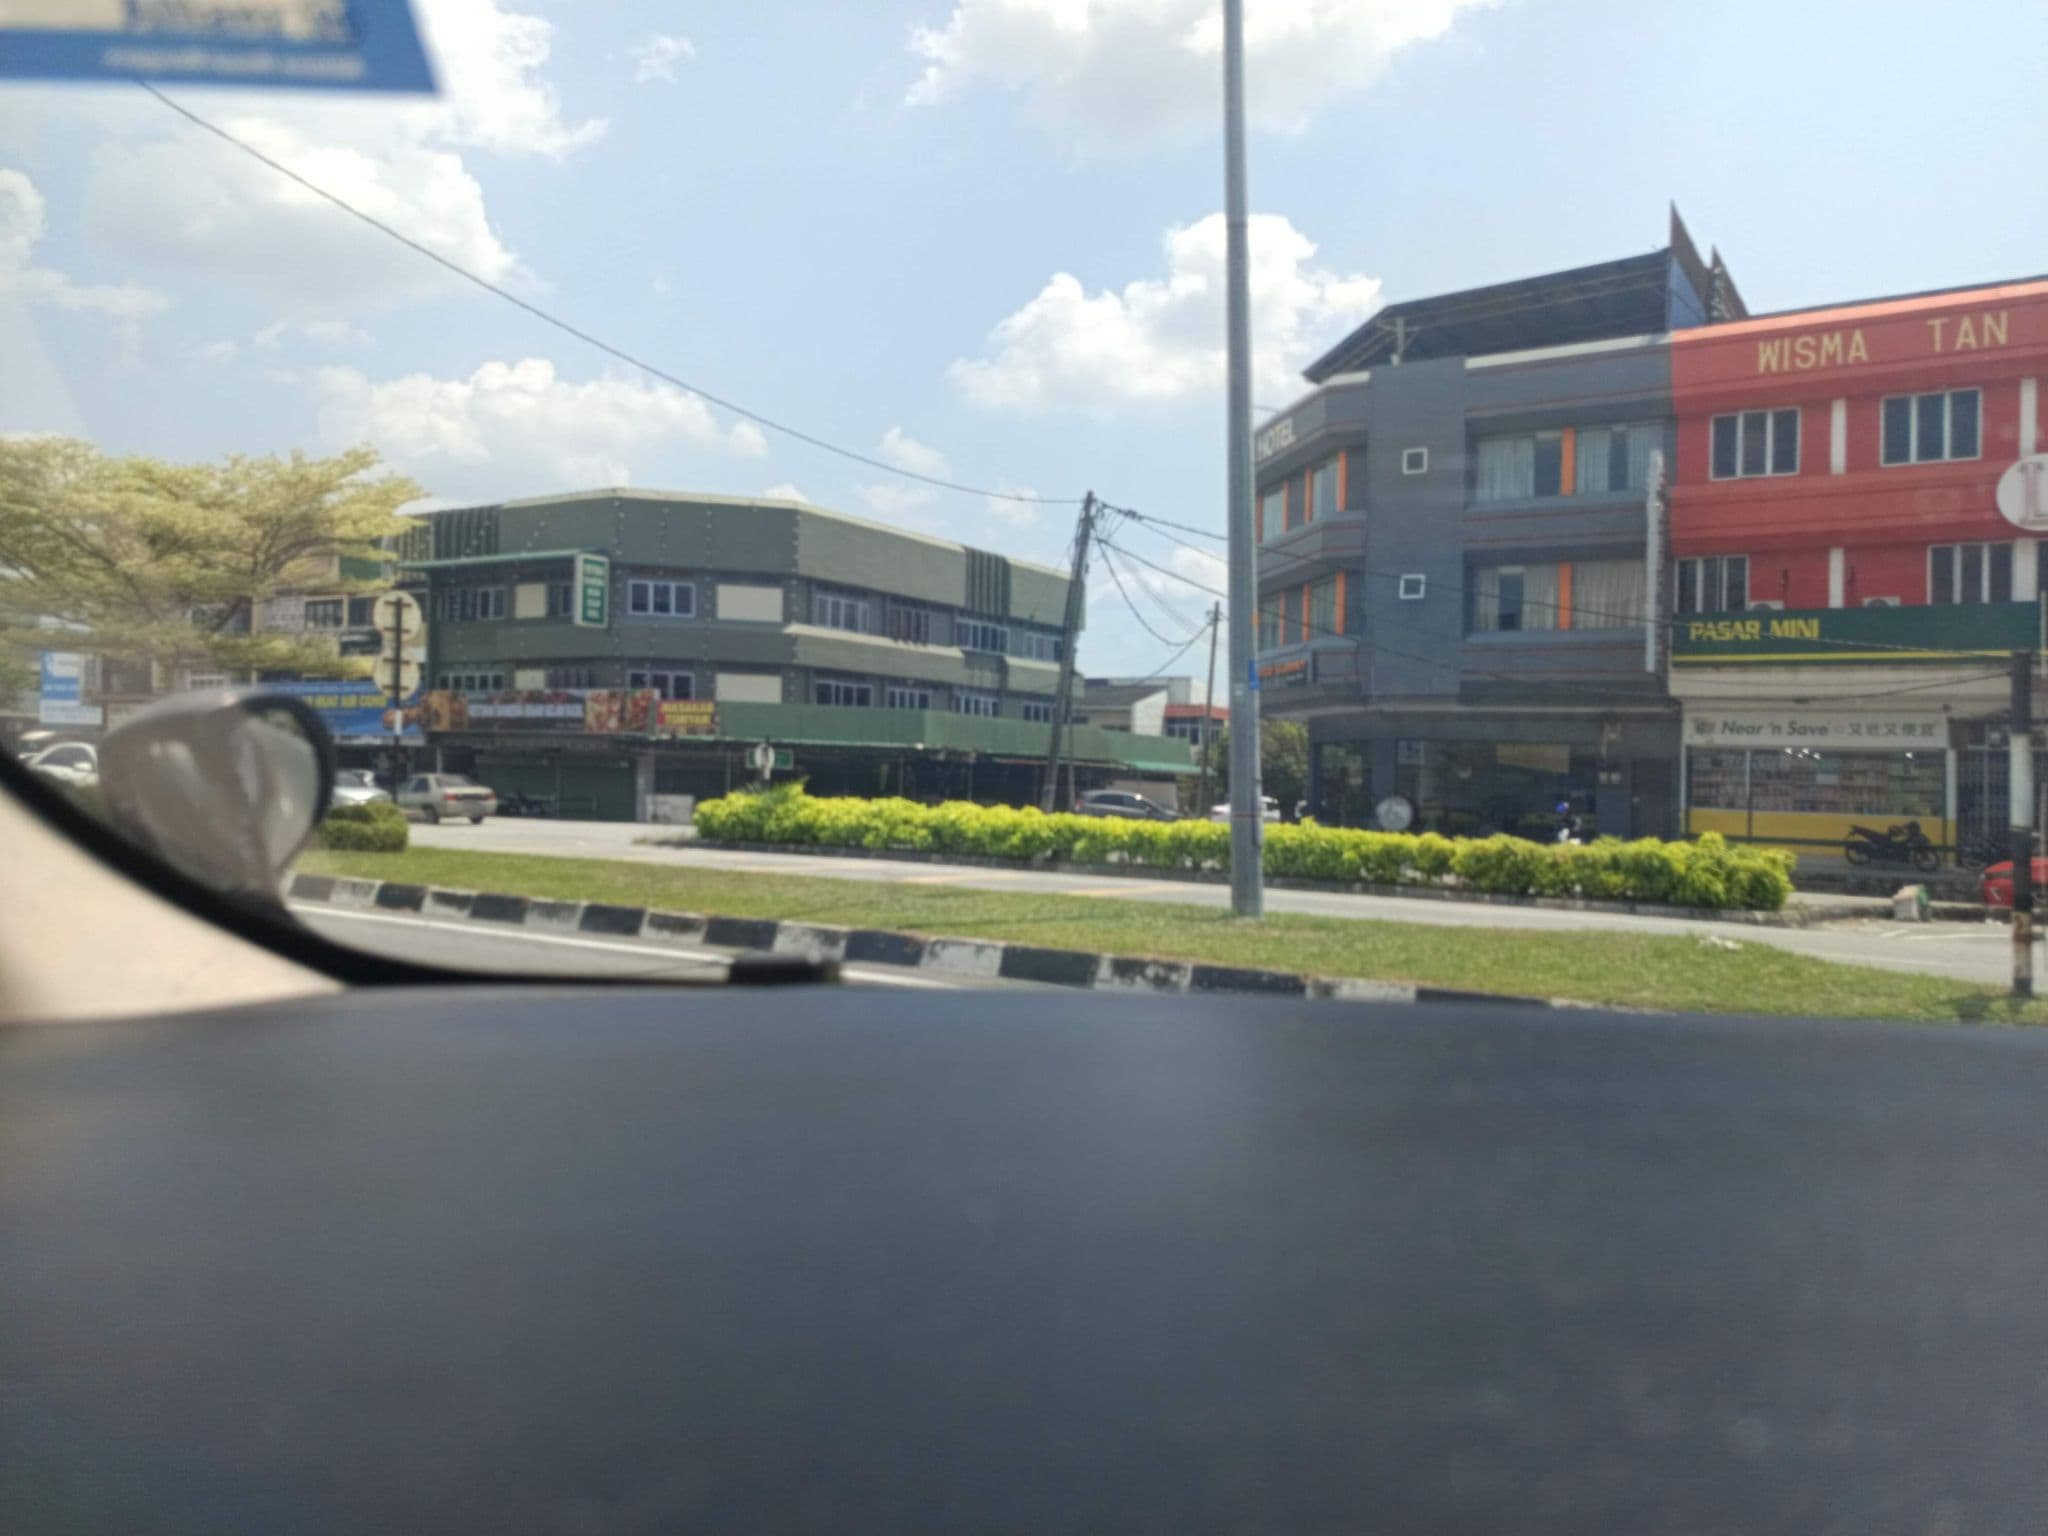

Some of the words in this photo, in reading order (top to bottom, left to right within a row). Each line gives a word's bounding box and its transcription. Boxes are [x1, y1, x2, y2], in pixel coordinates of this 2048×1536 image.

[1757, 329, 1869, 374] WISMA
[1927, 311, 2009, 353] TAN
[1256, 418, 1297, 460] HOTEL
[1689, 619, 1761, 642] PASAR
[1769, 618, 1820, 640] MINI
[1721, 719, 1764, 736] Near
[1787, 719, 1829, 736] Save
